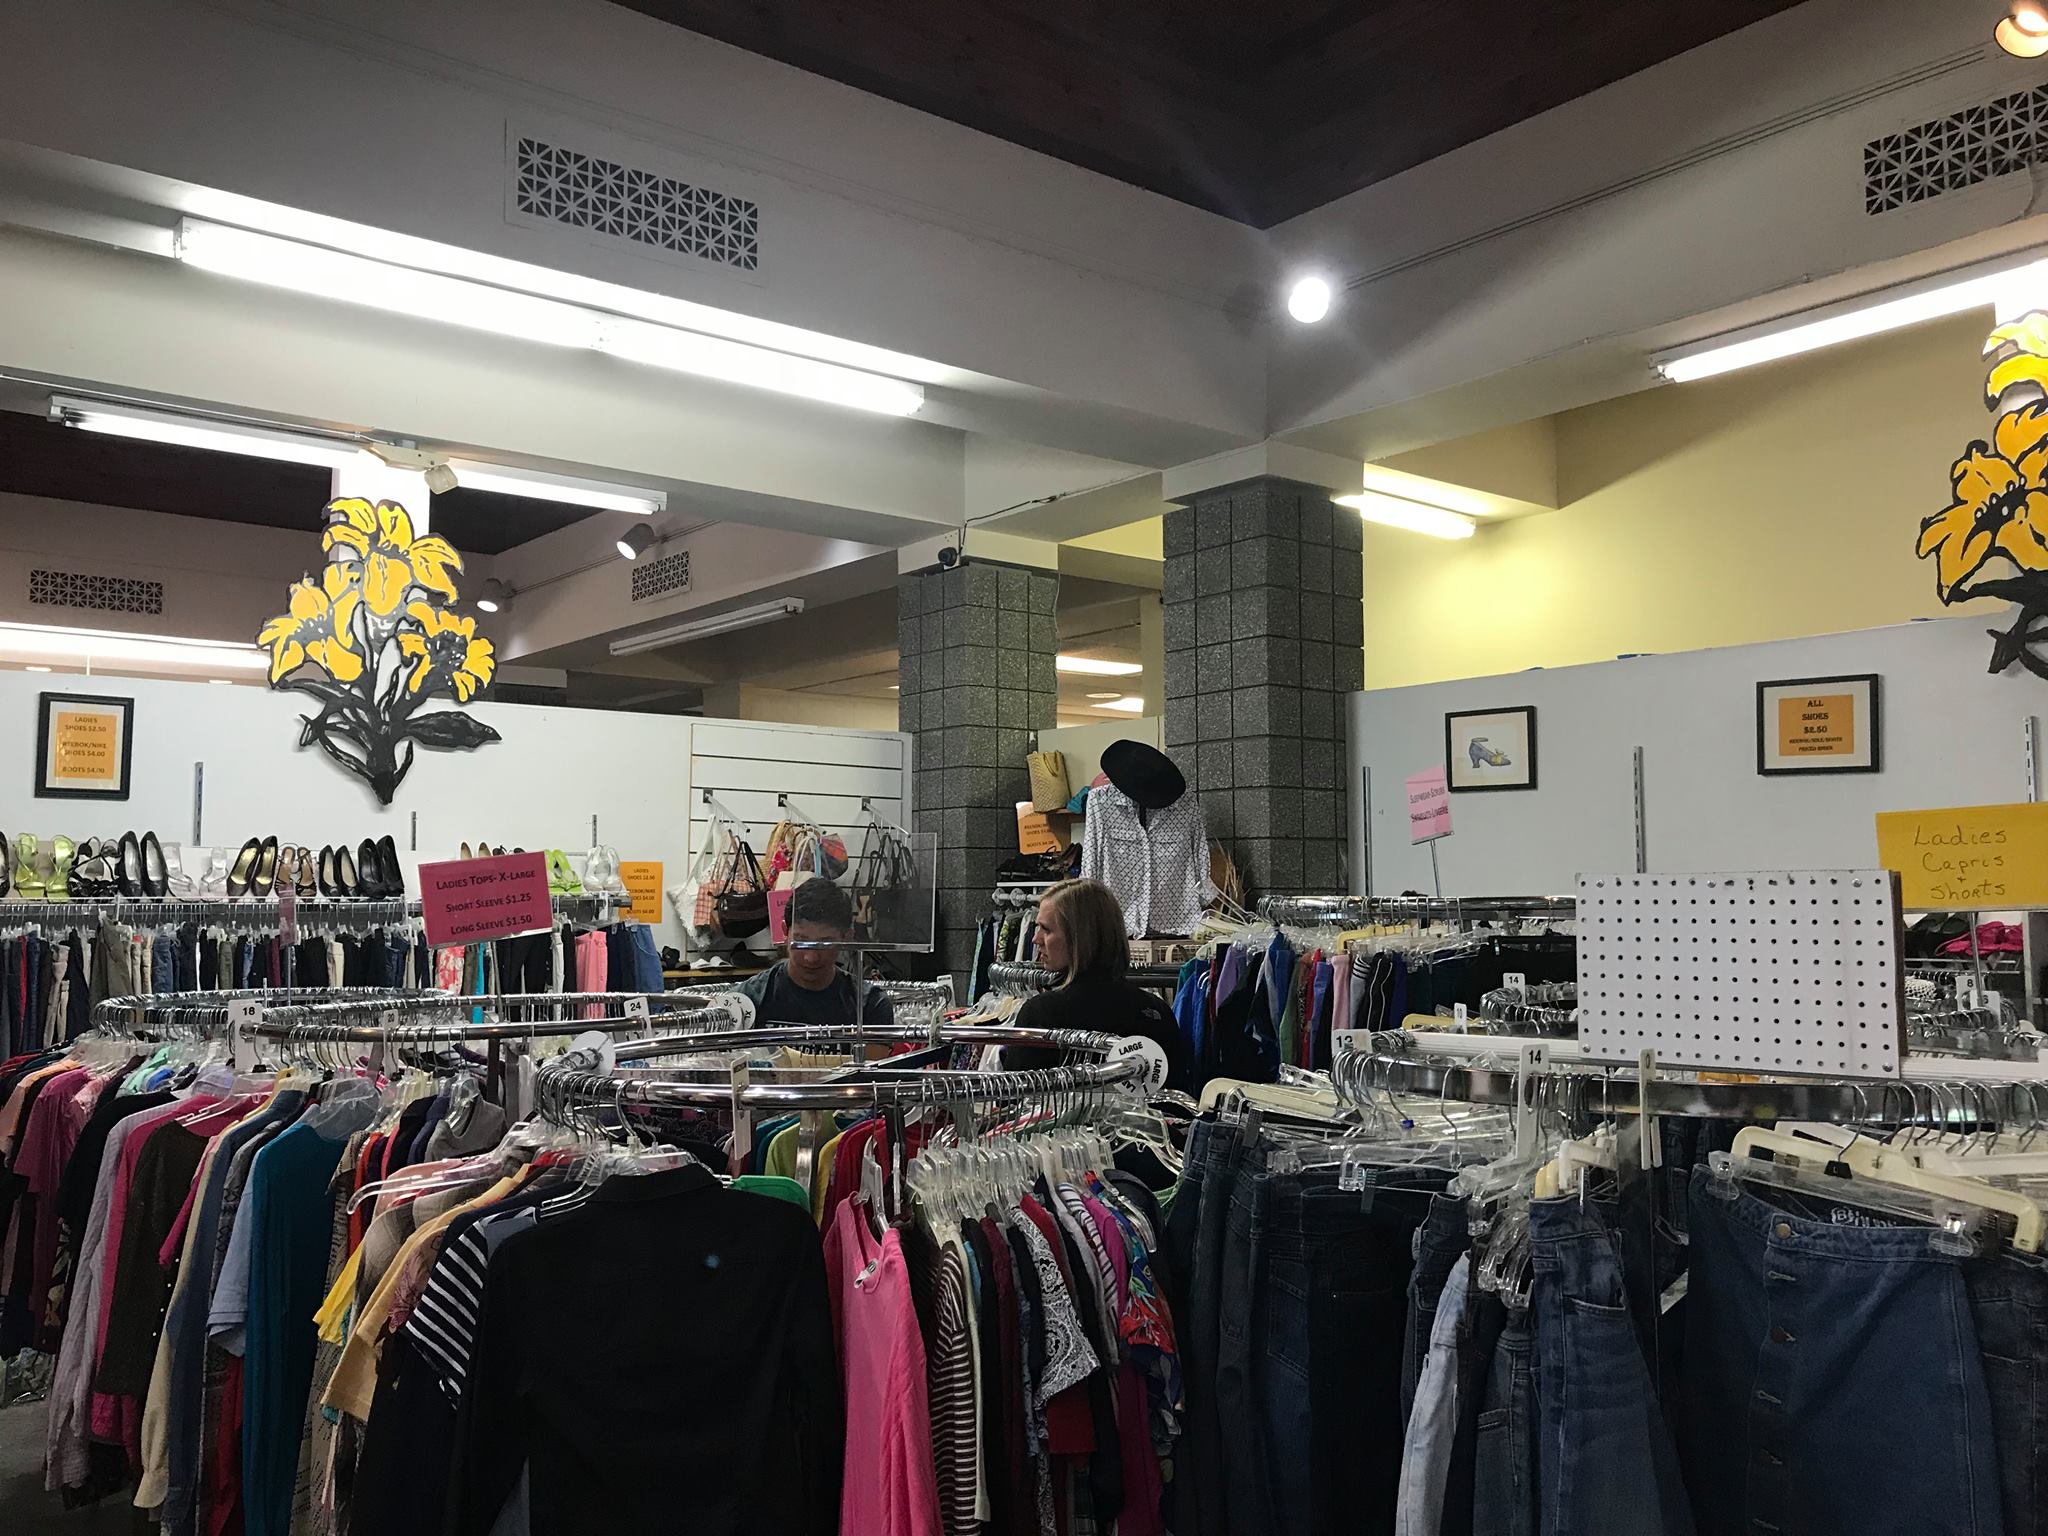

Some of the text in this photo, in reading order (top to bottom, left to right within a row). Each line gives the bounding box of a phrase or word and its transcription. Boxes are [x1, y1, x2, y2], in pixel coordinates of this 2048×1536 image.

[1807, 699, 1824, 708] ALL
[74, 716, 98, 724] LADIES
[1801, 712, 1829, 721] SHOES
[1803, 725, 1828, 734] $2.50
[1914, 825, 2007, 846] Ladies
[1922, 851, 2004, 873] Capris
[436, 878, 468, 890] LADIES
[499, 870, 536, 882] X-LARGE
[446, 892, 532, 913] SHORT SLEEVE $1.25
[450, 914, 532, 935] LONG SLEEVE $1.50
[1508, 976, 1519, 984] 14
[1967, 979, 1974, 987] 8
[242, 1006, 256, 1016] 18
[630, 1001, 642, 1012] 24
[1118, 1041, 1144, 1056] LARGE
[1528, 1049, 1542, 1065] 14
[1151, 1058, 1163, 1085] LARGE
